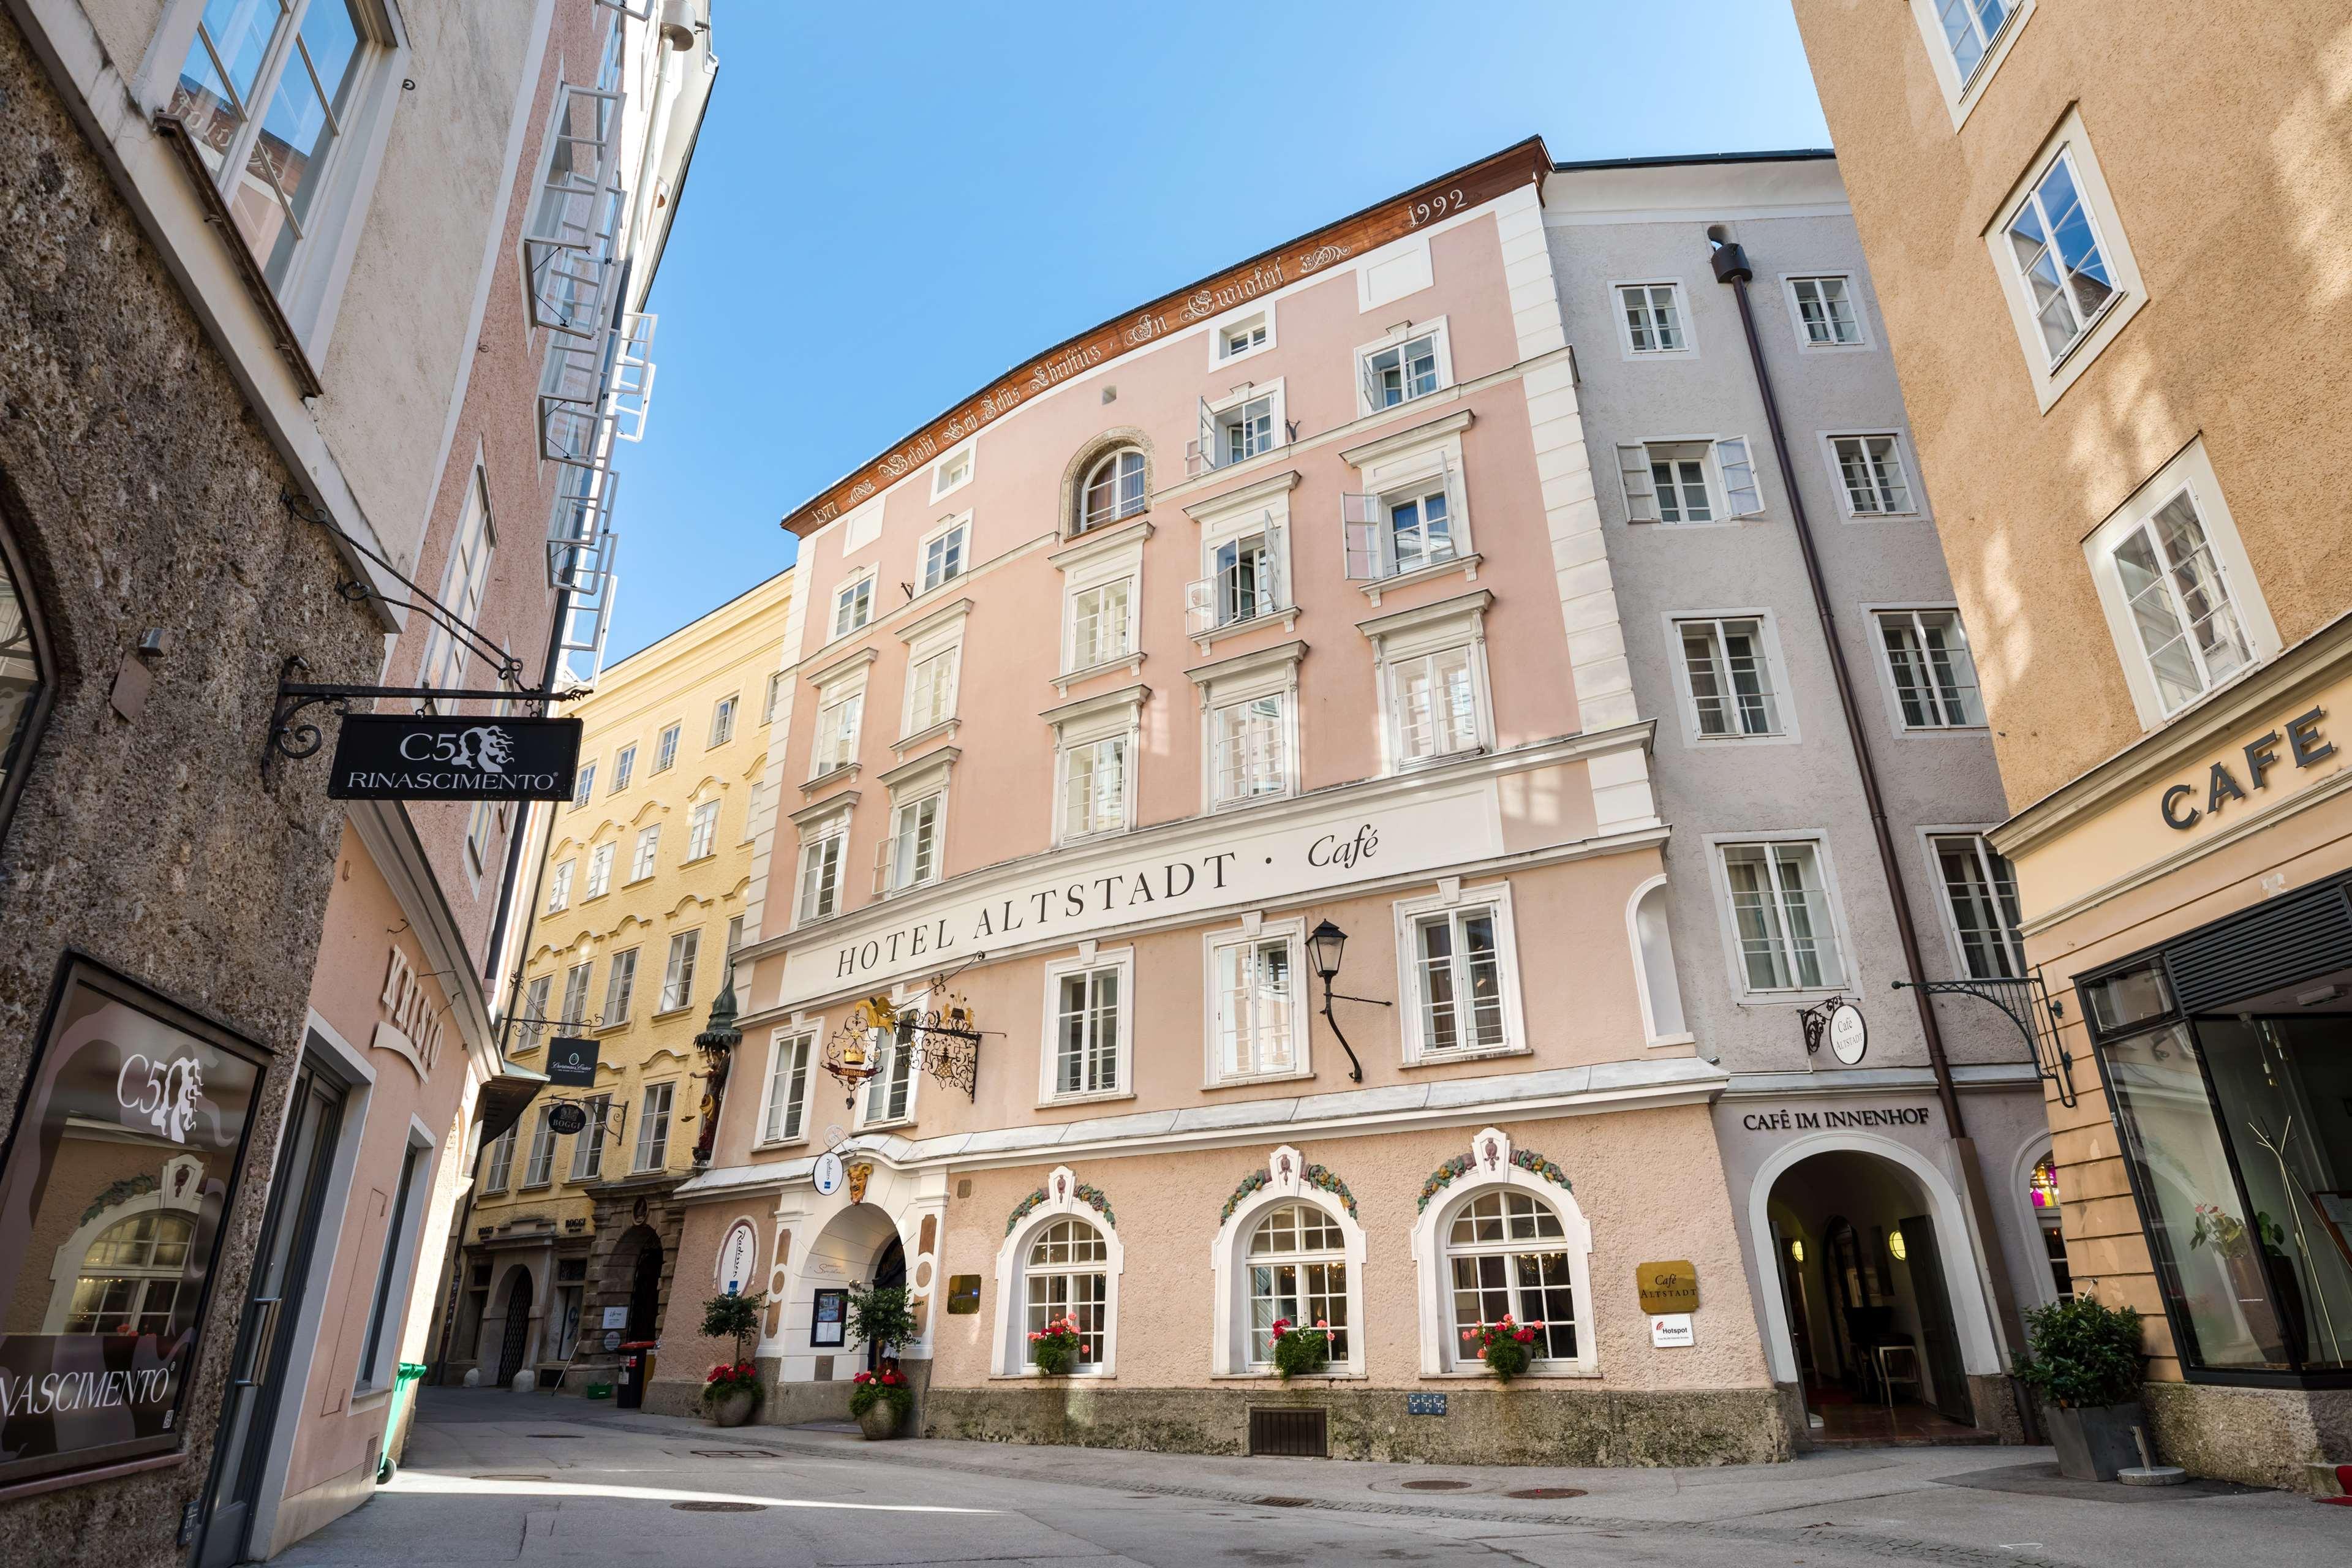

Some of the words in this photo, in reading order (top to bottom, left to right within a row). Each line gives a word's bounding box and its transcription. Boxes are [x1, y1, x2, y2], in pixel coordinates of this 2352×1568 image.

[812, 501, 837, 525] 1377
[1408, 189, 1468, 228] 1992
[2161, 704, 2334, 830] CAFE
[835, 918, 955, 979] HOTEL
[973, 851, 1236, 940] ALTSTADT
[1307, 824, 1378, 869] Café
[1838, 1017, 1853, 1033] Café
[1836, 1033, 1863, 1052] ALTSTADT
[553, 1119, 581, 1129] BOGGI
[1743, 1109, 1792, 1131] CAFÉ
[1795, 1112, 1820, 1129] IM
[1823, 1107, 1929, 1128] INNENHOF
[734, 1230, 746, 1277] Radisson
[1655, 1273, 1677, 1289] Café
[1641, 1289, 1697, 1299] ALTSTADT
